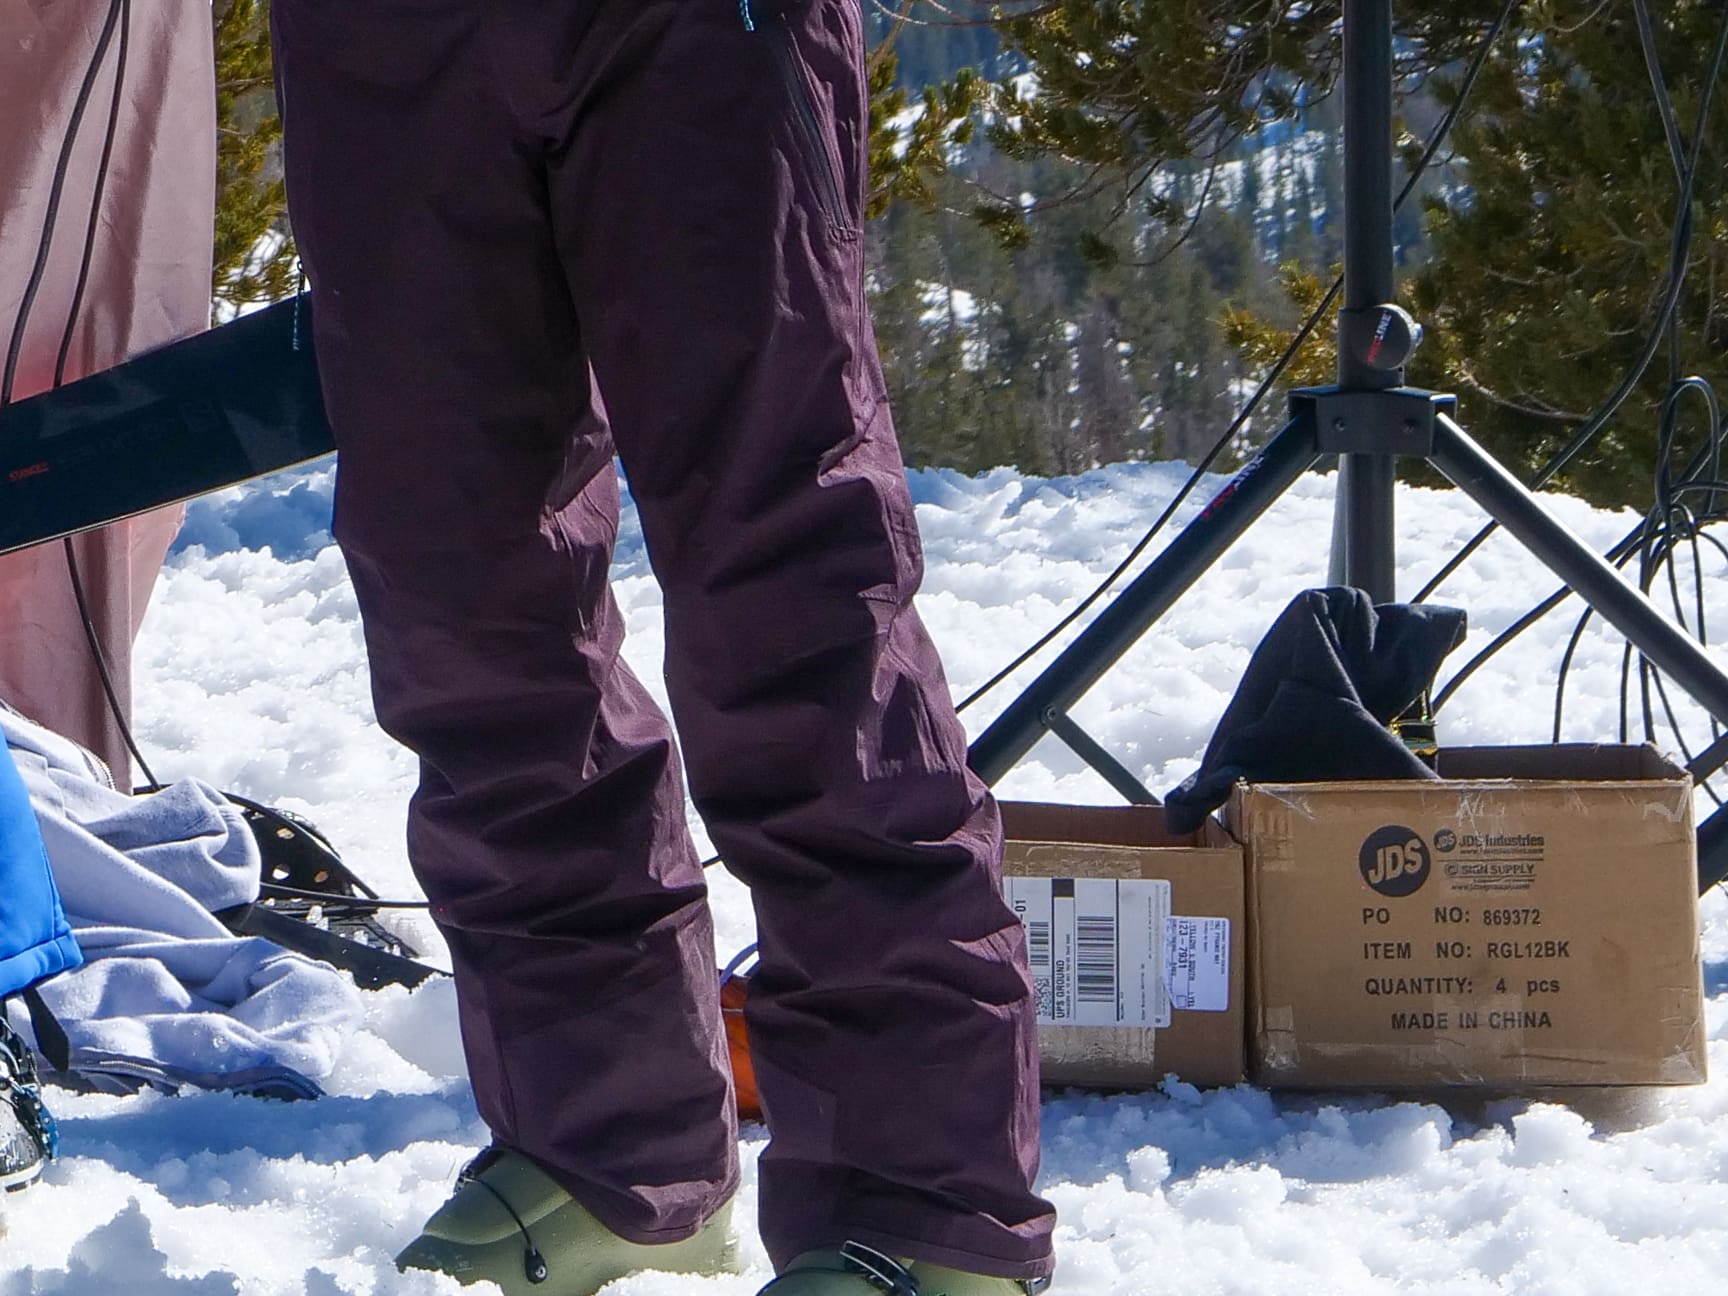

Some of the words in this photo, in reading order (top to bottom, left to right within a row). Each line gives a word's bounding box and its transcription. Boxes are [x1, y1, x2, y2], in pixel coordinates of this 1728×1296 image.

[1459, 835, 1483, 847] JDS
[1485, 834, 1544, 847] Industries
[1368, 838, 1423, 885] JDS
[1490, 864, 1534, 875] SUPPLY
[1362, 908, 1391, 924] PO
[1434, 907, 1470, 923] NO:
[1483, 909, 1541, 925] 869372
[1363, 943, 1412, 959] ITEM
[1436, 942, 1472, 958] NO:
[1487, 941, 1570, 958] RGL12BK
[1055, 960, 1065, 996] GROUND
[1365, 977, 1473, 995] QUANTITY:
[1496, 978, 1507, 993] 4
[1527, 979, 1560, 996] pcs
[1055, 997, 1065, 1019] UPS
[1391, 1013, 1448, 1029] MADE
[1459, 1013, 1478, 1028] IN
[1488, 1012, 1552, 1029] CHINA
